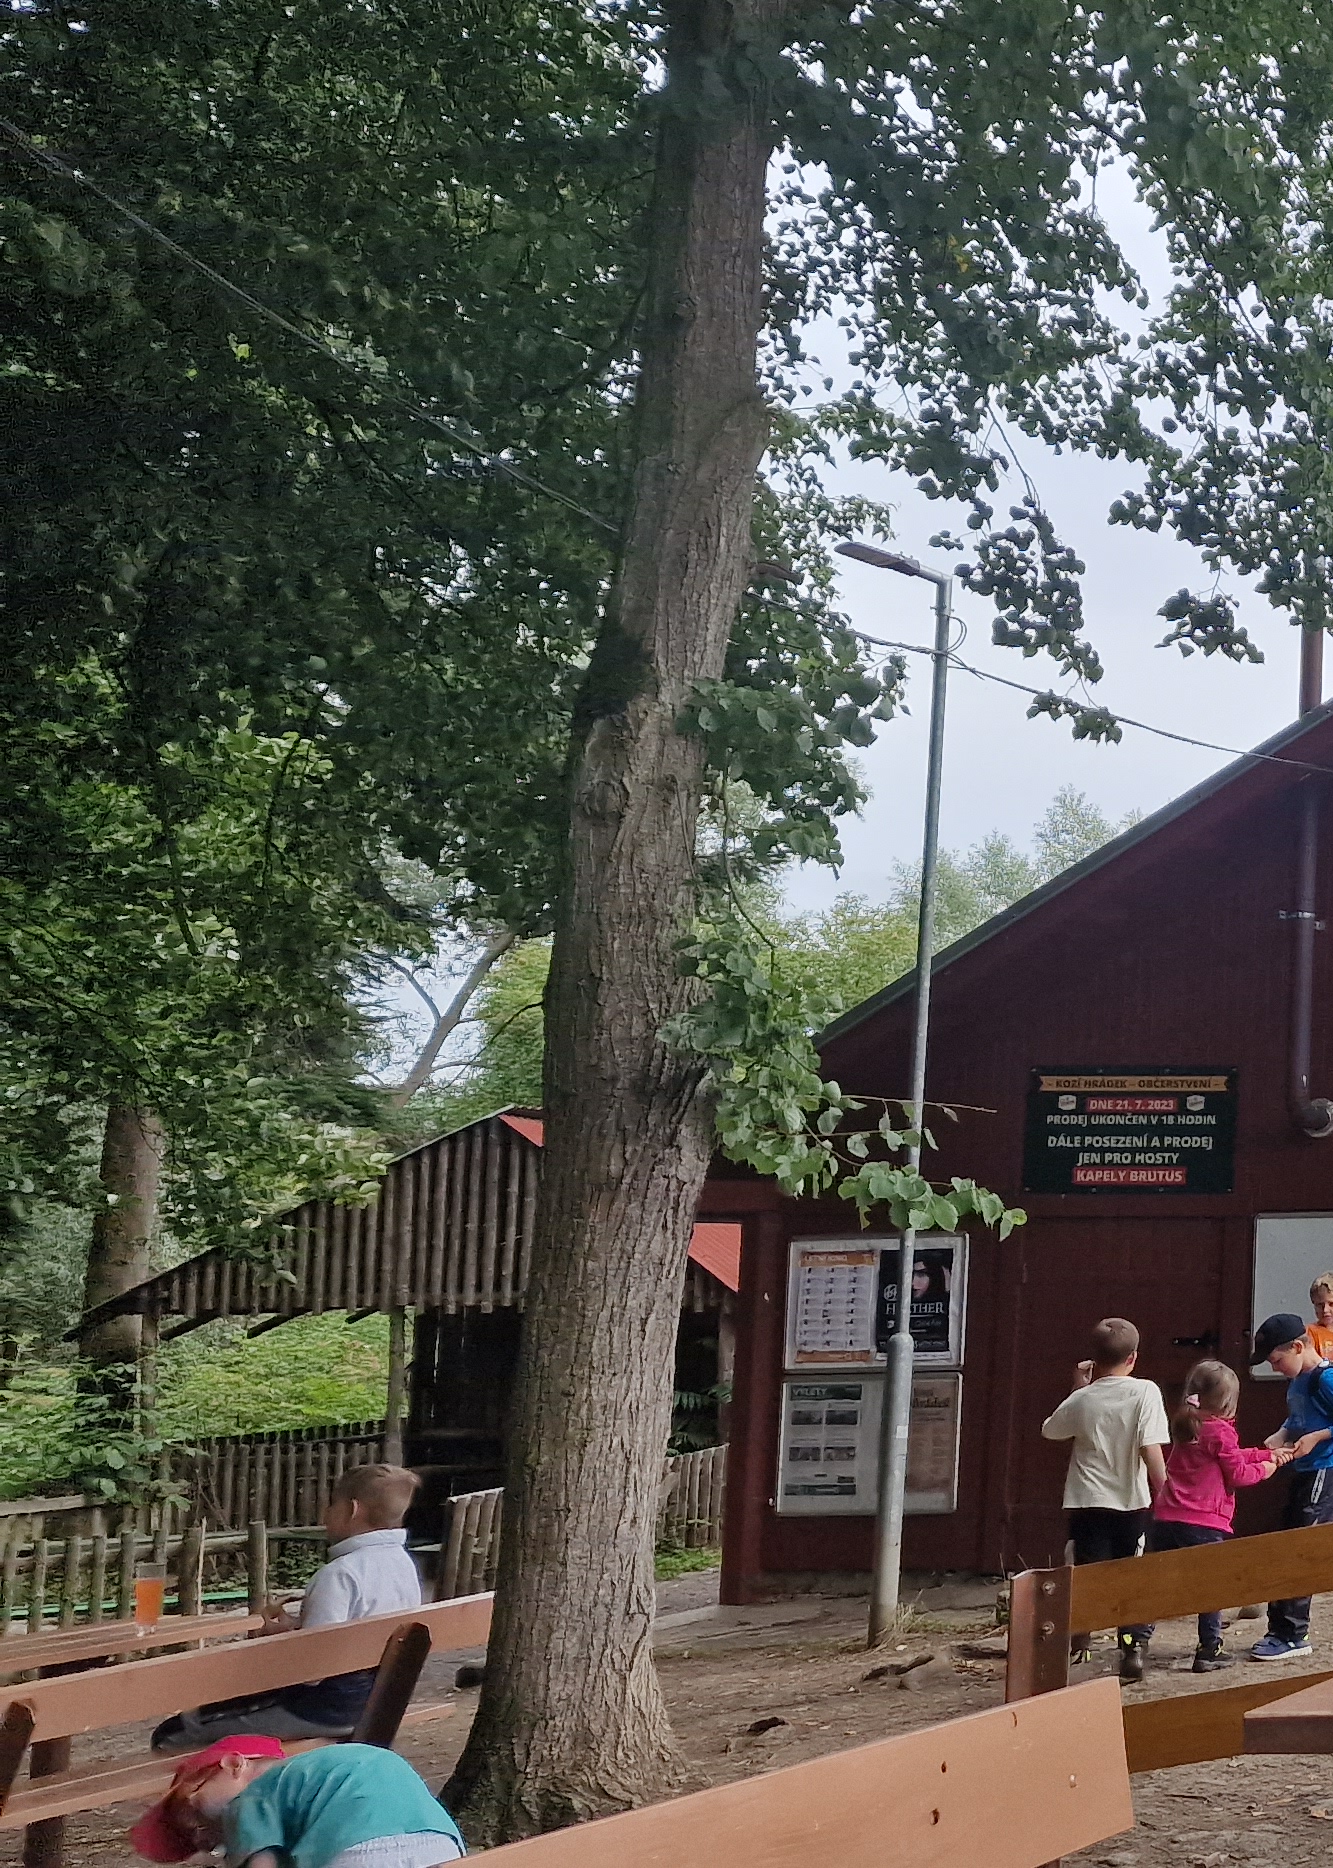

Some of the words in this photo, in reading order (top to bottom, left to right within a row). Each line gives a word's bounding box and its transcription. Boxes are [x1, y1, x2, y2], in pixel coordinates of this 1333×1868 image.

[1055, 1077, 1081, 1088] KOZÍ
[1083, 1077, 1127, 1088] HRÁDEK
[1138, 1077, 1212, 1088] OBČERSTVENÍ
[1089, 1100, 1113, 1110] DNE
[1116, 1100, 1133, 1110] 21.
[1135, 1100, 1145, 1110] 7.
[1147, 1100, 1174, 1110] 2023
[1046, 1114, 1088, 1127] PRODEJ
[1090, 1112, 1148, 1125] UKONČEN
[1149, 1115, 1159, 1125] V
[1162, 1115, 1175, 1125] 18
[1177, 1115, 1217, 1125] HODIN
[1047, 1133, 1081, 1148] DÁLE
[1084, 1133, 1148, 1148] POSEZENÍ
[1150, 1136, 1161, 1148] A
[1164, 1136, 1213, 1150] PRODEJ
[1076, 1152, 1101, 1166] JEN
[1104, 1152, 1132, 1164] PRO
[1134, 1152, 1180, 1164] HOSTY
[1076, 1170, 1127, 1182] KAPELY
[1129, 1170, 1183, 1182] BRUTUS
